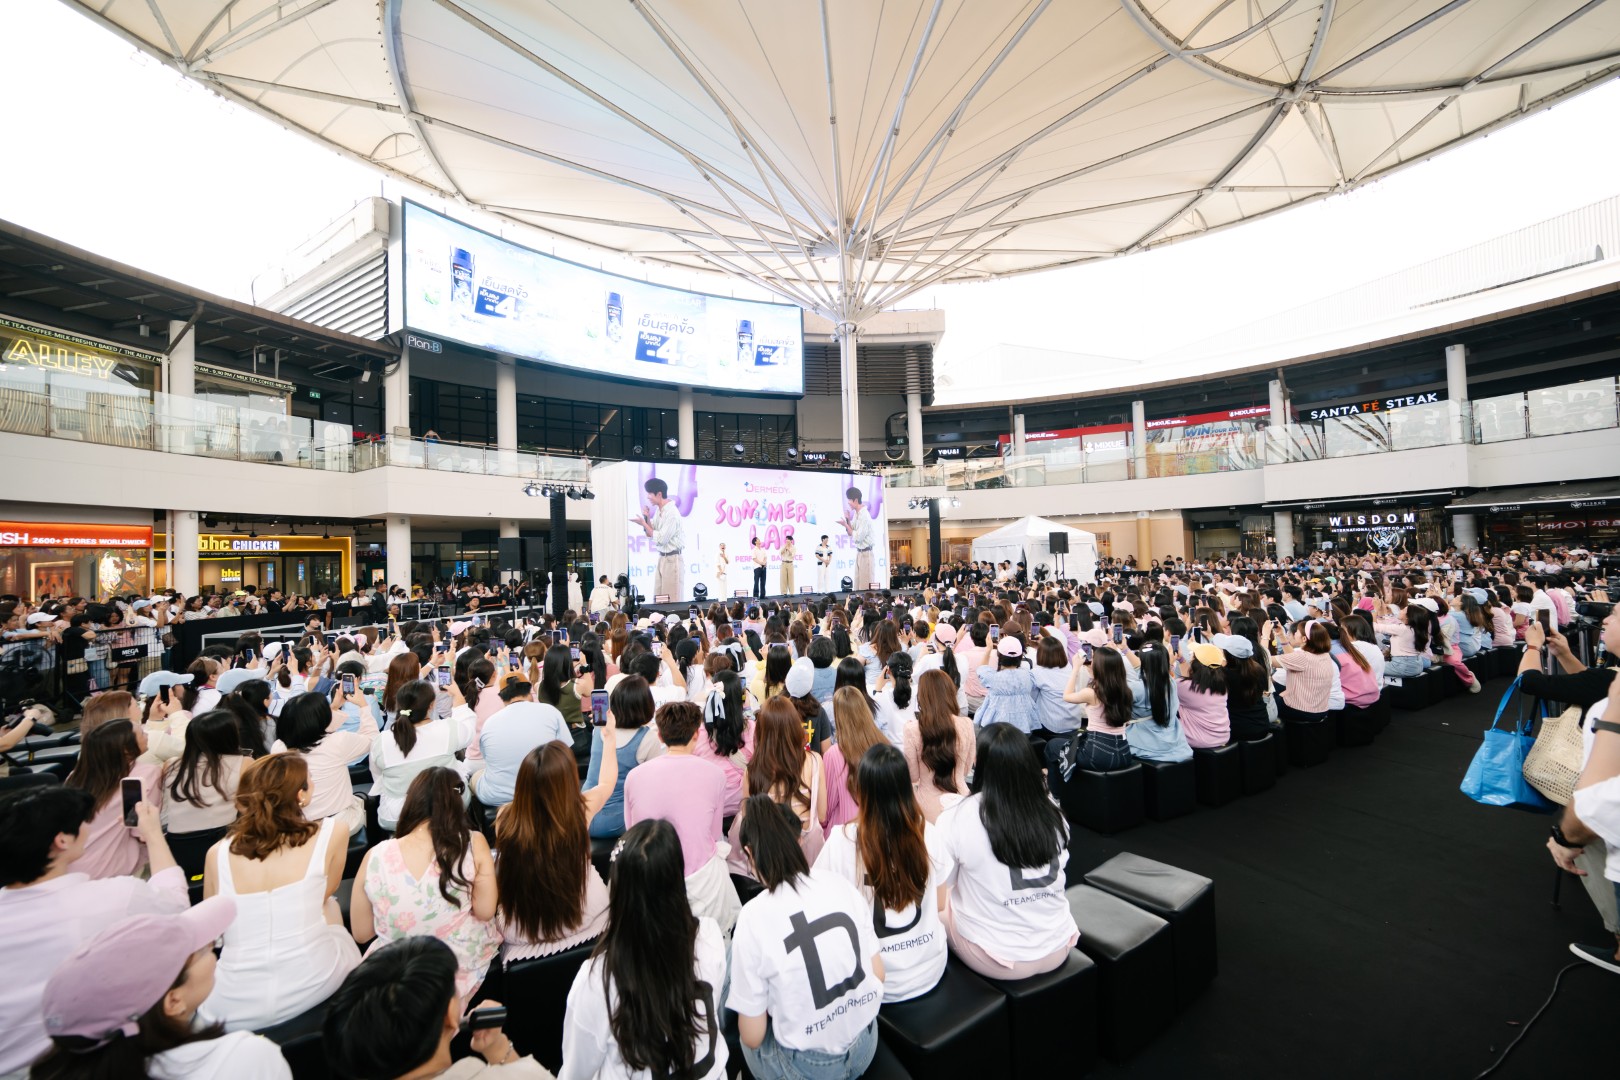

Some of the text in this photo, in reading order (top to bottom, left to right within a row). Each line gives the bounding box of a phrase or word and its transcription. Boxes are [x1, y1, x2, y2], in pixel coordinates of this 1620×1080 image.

[638, 313, 695, 335] เย็นสุดขั้ว
[8, 339, 114, 379] ALLEY
[1310, 404, 1360, 420] SANTA
[1386, 392, 1438, 409] STEAK
[1185, 426, 1211, 437] WIN
[1094, 440, 1125, 450] MIXUE
[1329, 513, 1415, 527] WISDOM
[63, 537, 97, 545] STORES
[198, 535, 280, 550] bhc CHICKEN
[221, 568, 240, 577] bhc
[121, 647, 139, 656] MEGA
